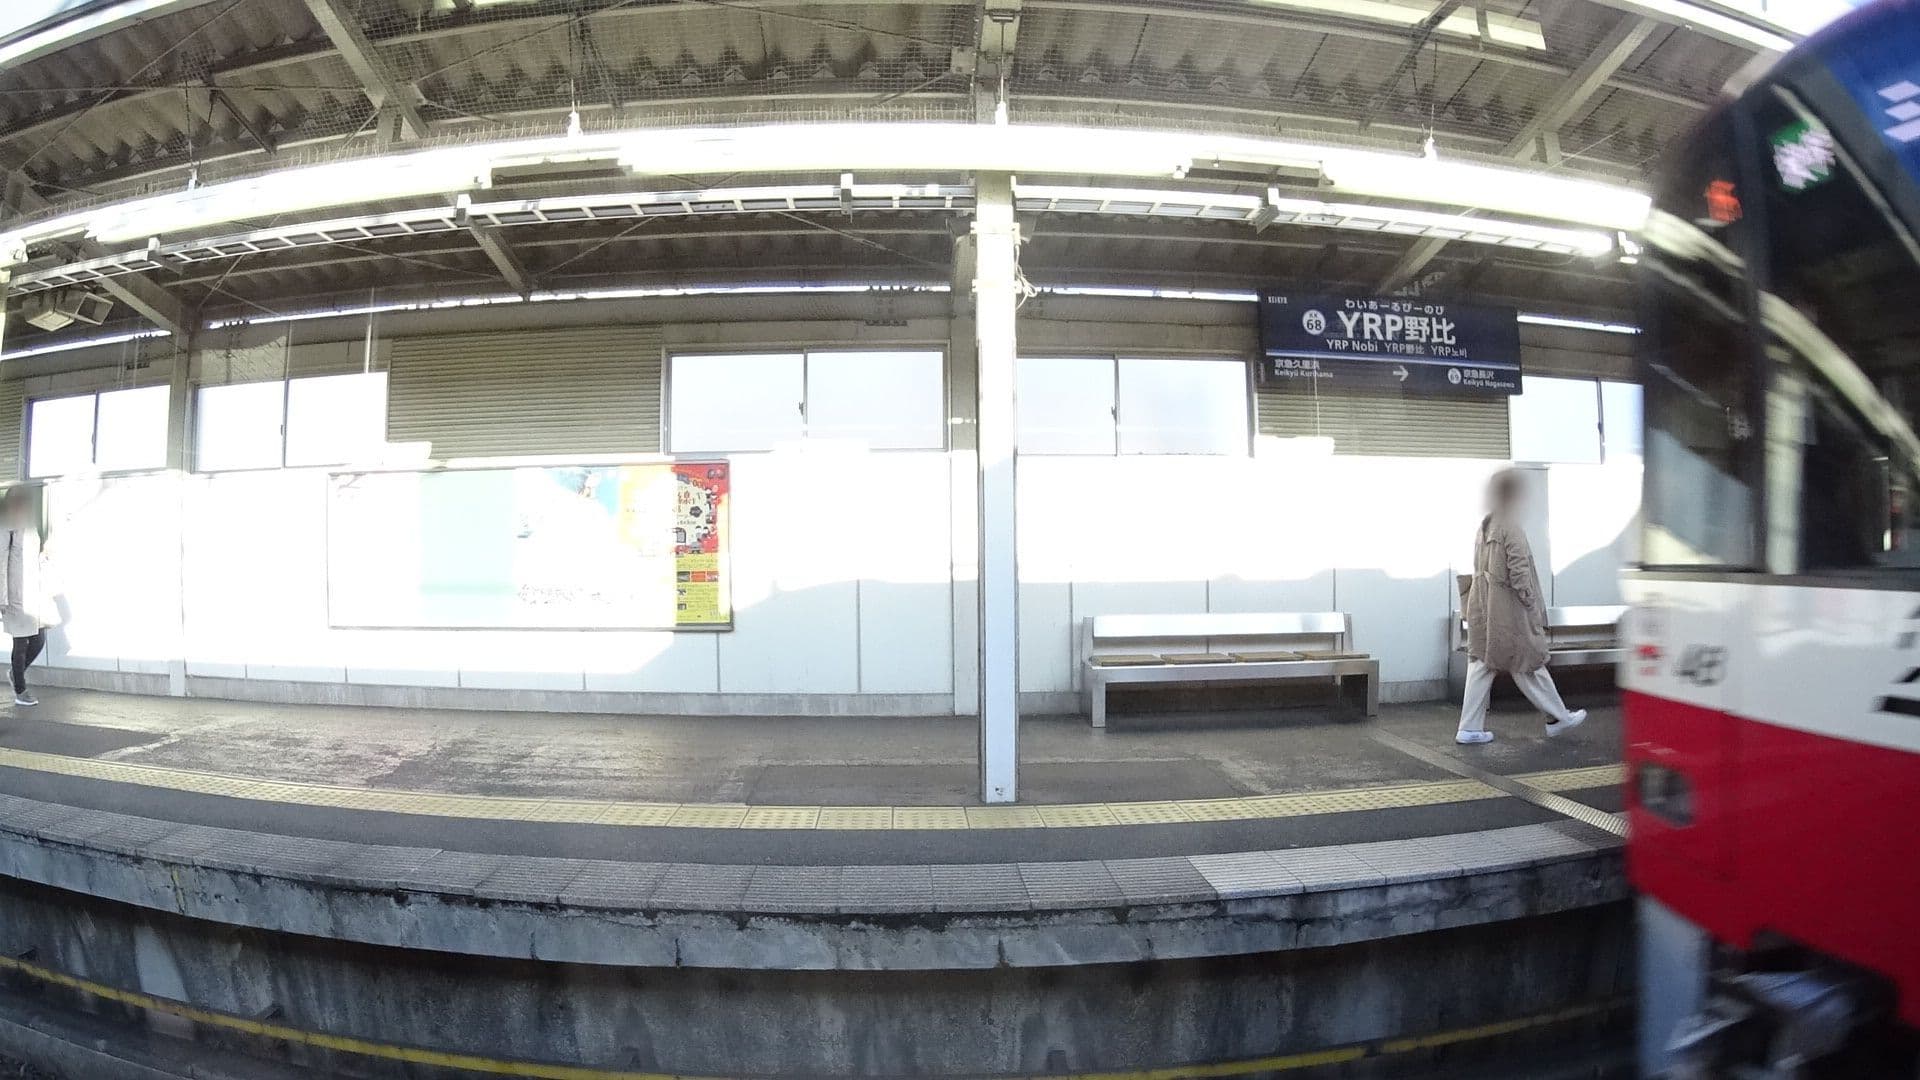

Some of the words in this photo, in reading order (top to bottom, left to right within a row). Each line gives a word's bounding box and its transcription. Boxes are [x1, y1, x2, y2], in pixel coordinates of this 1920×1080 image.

[1306, 319, 1322, 331] 68
[1336, 310, 1456, 345] YRP野比
[1326, 339, 1349, 350] YRP
[1352, 341, 1378, 353] Nobi
